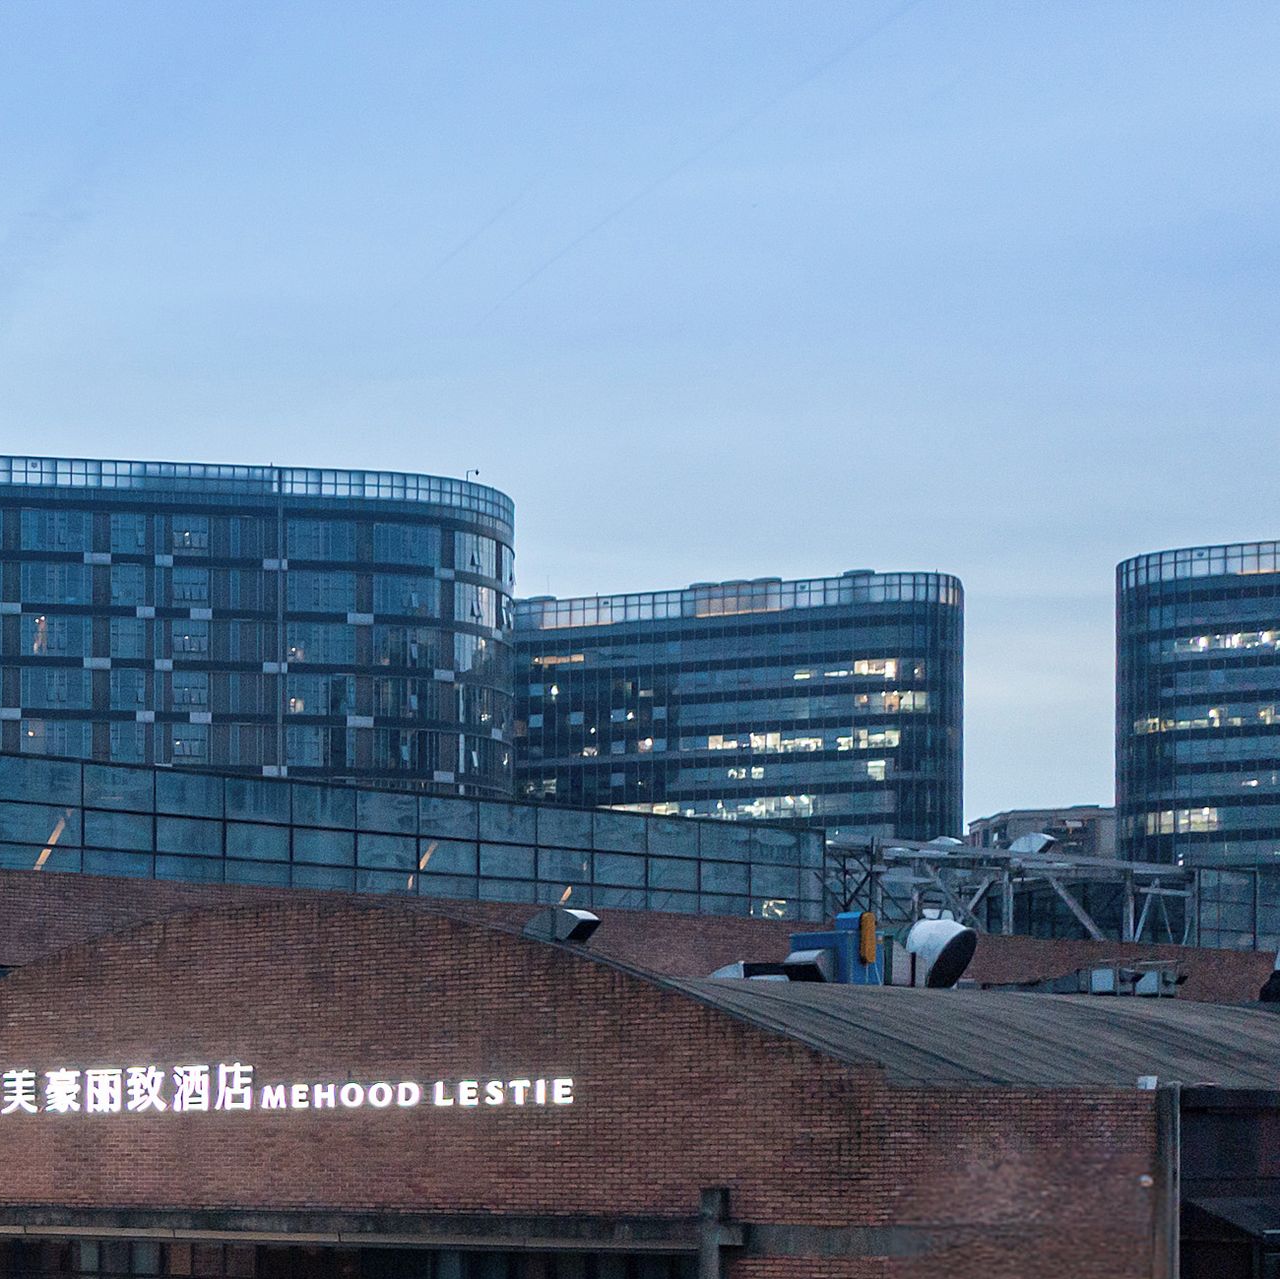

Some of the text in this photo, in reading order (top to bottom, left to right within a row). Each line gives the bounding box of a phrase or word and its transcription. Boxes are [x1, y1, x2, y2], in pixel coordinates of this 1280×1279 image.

[0, 1063, 574, 1113] 美豪丽致酒店 MEHOOD LESTIE
